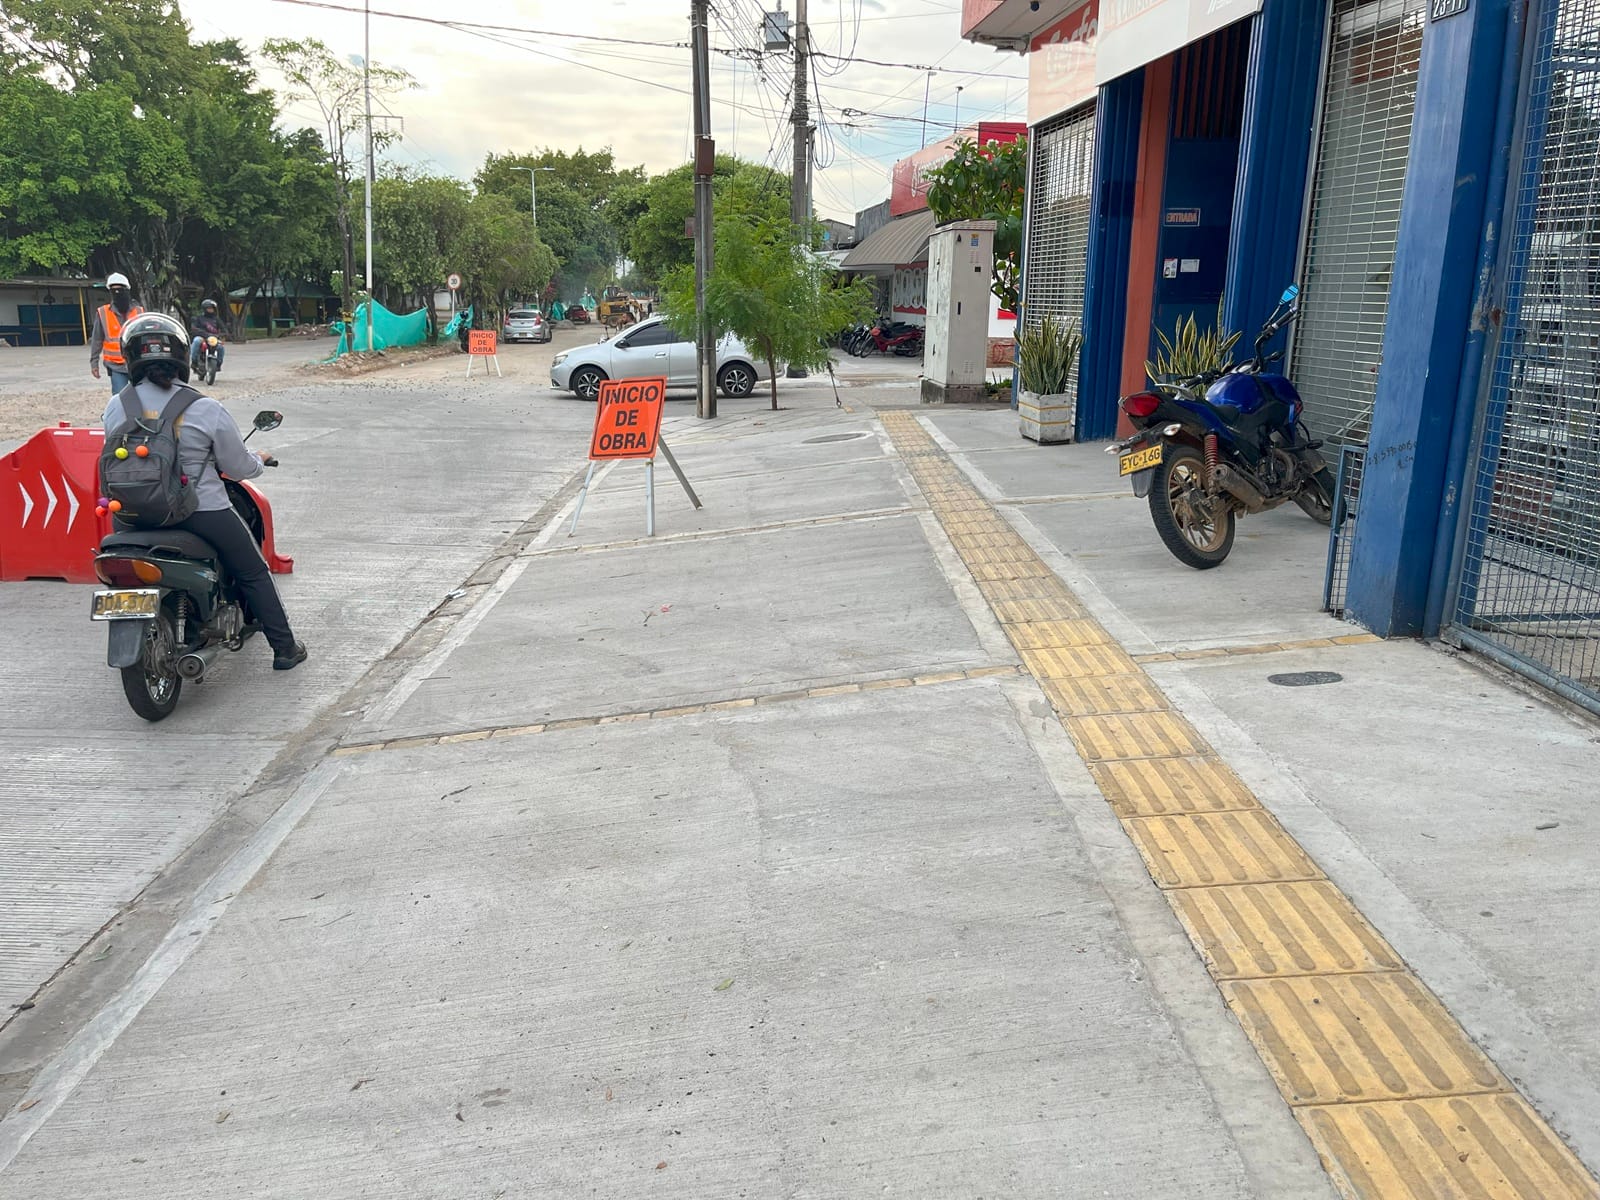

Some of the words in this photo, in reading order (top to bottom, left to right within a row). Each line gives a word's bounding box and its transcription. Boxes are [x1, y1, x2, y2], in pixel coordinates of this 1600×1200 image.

[1166, 212, 1198, 223] ENTRADA
[471, 331, 494, 339] INICIO
[605, 385, 659, 405] INICIO
[615, 409, 639, 427] DE
[599, 431, 647, 451] OBRA
